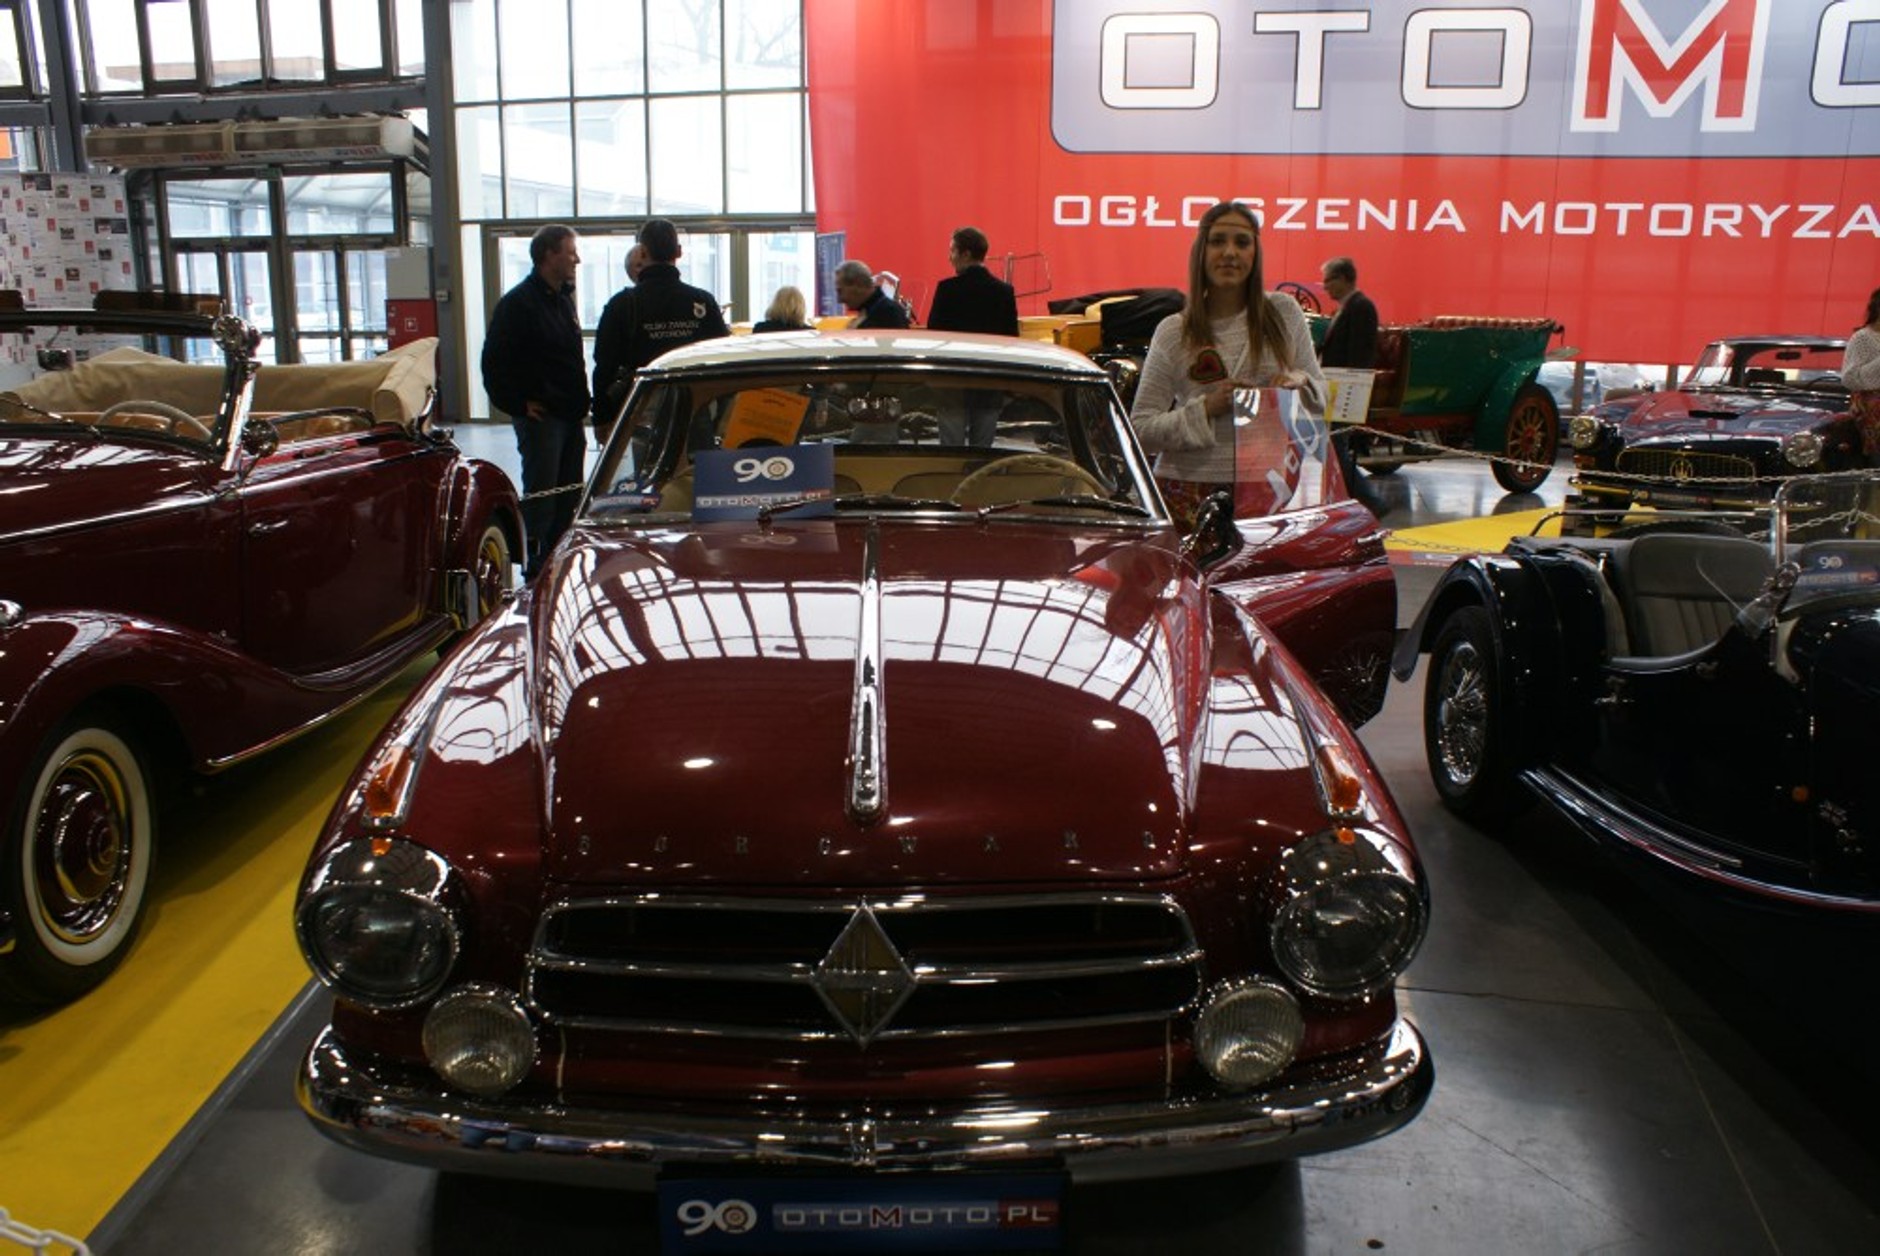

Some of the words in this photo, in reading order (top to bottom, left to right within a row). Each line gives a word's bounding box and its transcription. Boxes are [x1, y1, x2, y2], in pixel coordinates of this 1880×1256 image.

[1499, 201, 1880, 239] MOTORYZA
[733, 456, 796, 483] 90
[677, 1199, 758, 1235] 90
[781, 1205, 1051, 1229] OTOMOTO.PL
